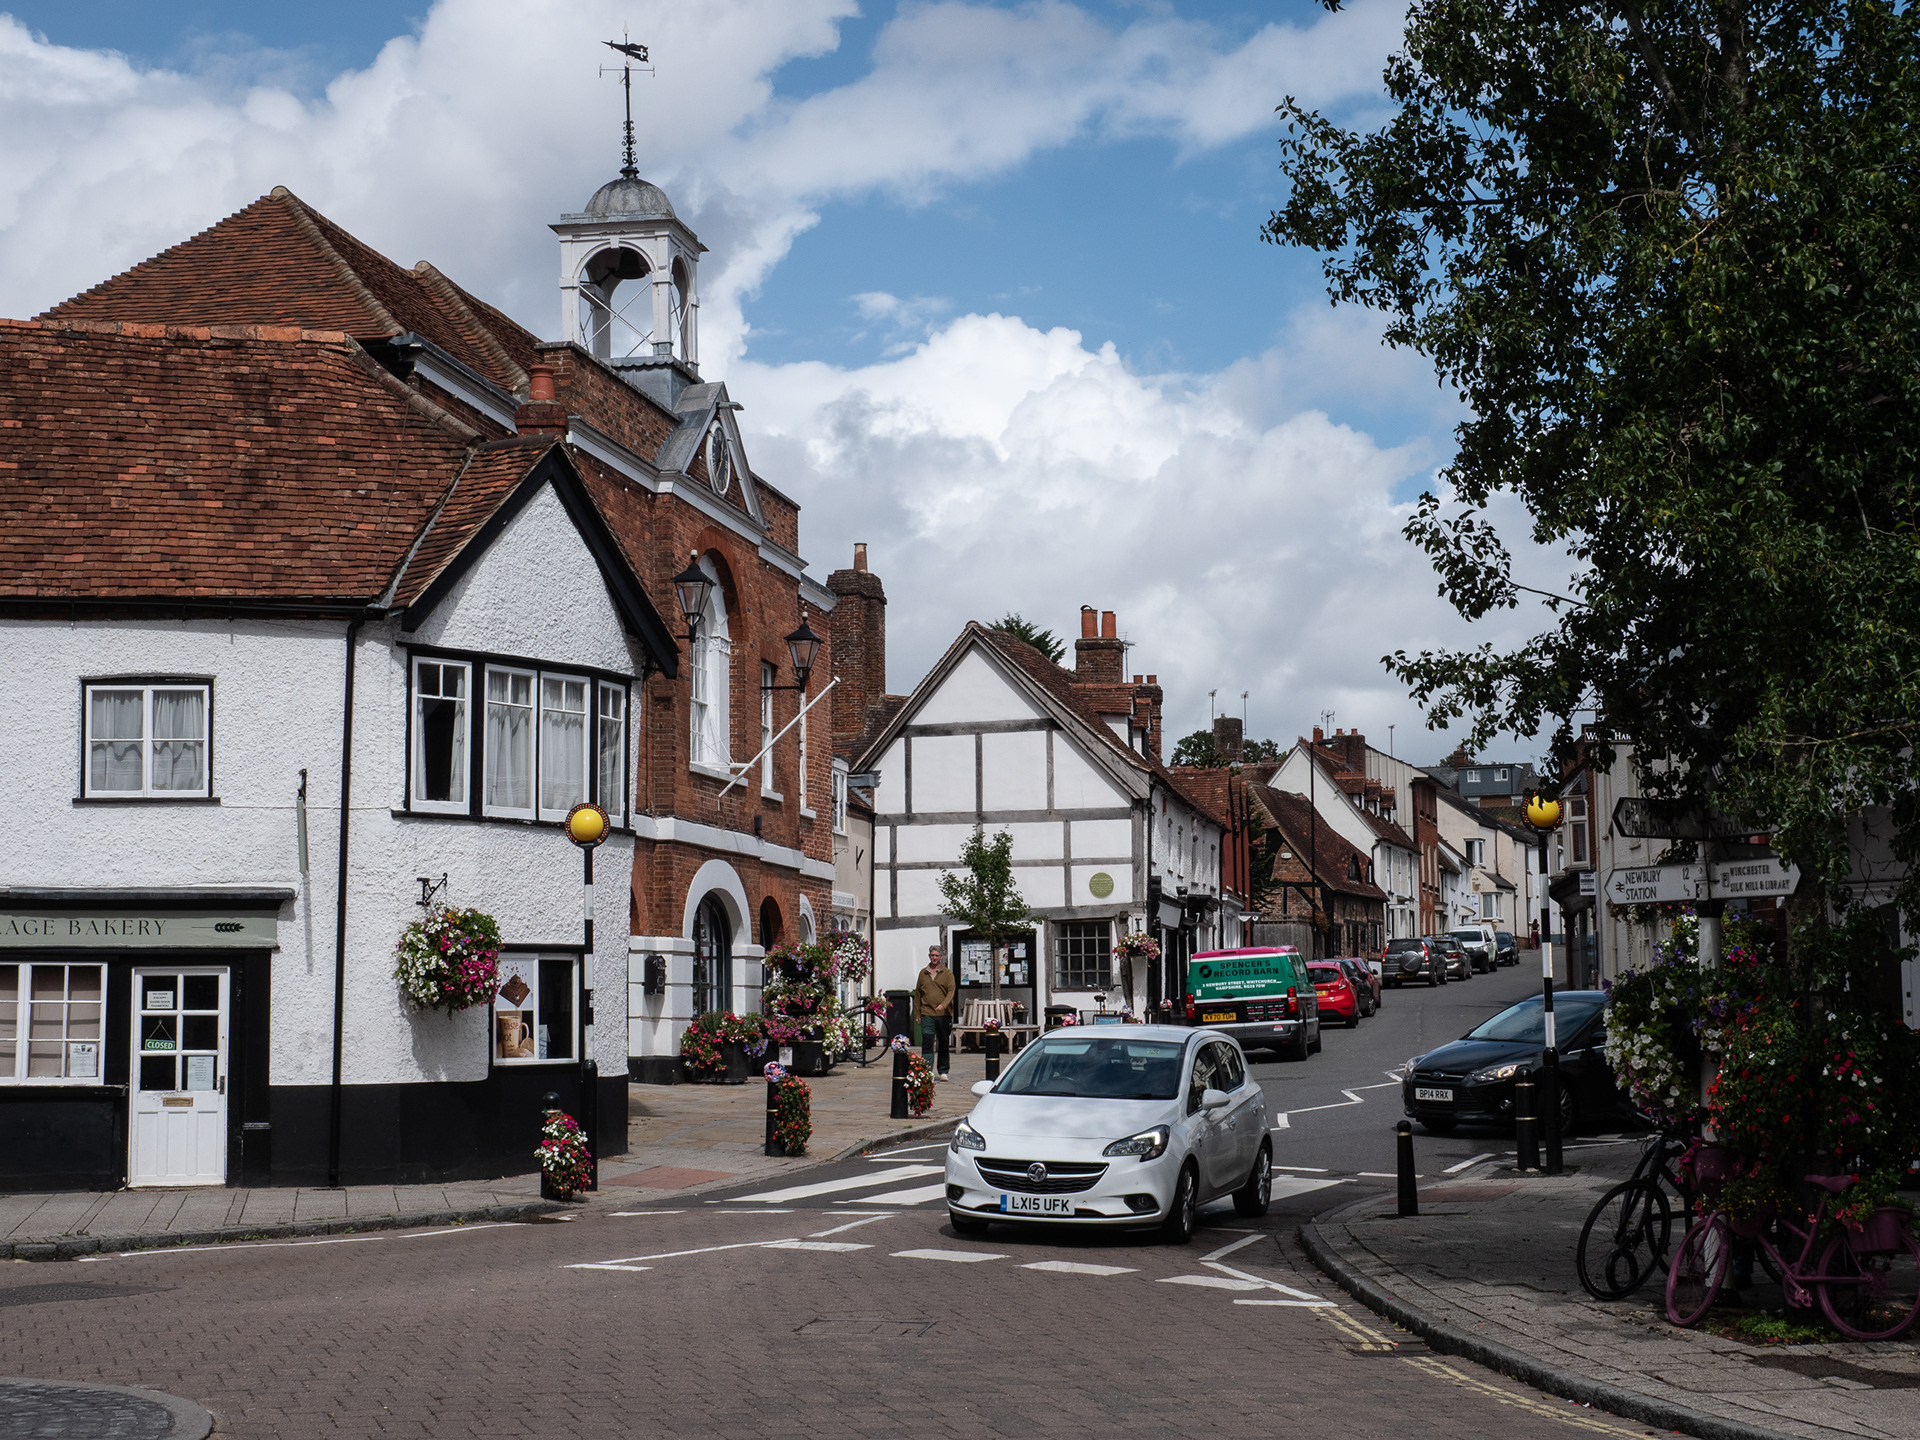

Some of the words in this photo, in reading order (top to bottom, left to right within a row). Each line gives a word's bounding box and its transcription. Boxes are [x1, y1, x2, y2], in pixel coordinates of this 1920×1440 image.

[1650, 822, 1680, 835] PARKING
[1625, 870, 1661, 884] NEWBURY
[1682, 867, 1690, 880] 12
[1729, 865, 1770, 876] WINCHESTER
[1730, 882, 1743, 892] SILK
[1745, 881, 1758, 891] MILL
[1759, 880, 1764, 890] &
[1765, 879, 1790, 890] LIBRARY
[1625, 886, 1657, 900] STATION
[0, 919, 55, 936] AGE
[68, 919, 167, 936] BAKERY
[1220, 960, 1271, 969] SPENCER'S
[1213, 968, 1251, 978] RECORD
[1253, 967, 1279, 976] BARN
[1204, 1013, 1221, 1021] KV70
[1222, 1012, 1234, 1020] TUH
[503, 1021, 519, 1030] taste
[147, 1041, 174, 1050] CLOSED
[1419, 1089, 1434, 1098] BP14
[1435, 1090, 1449, 1100] RRX
[1011, 1196, 1040, 1210] LX15
[1043, 1198, 1070, 1212] UFK
